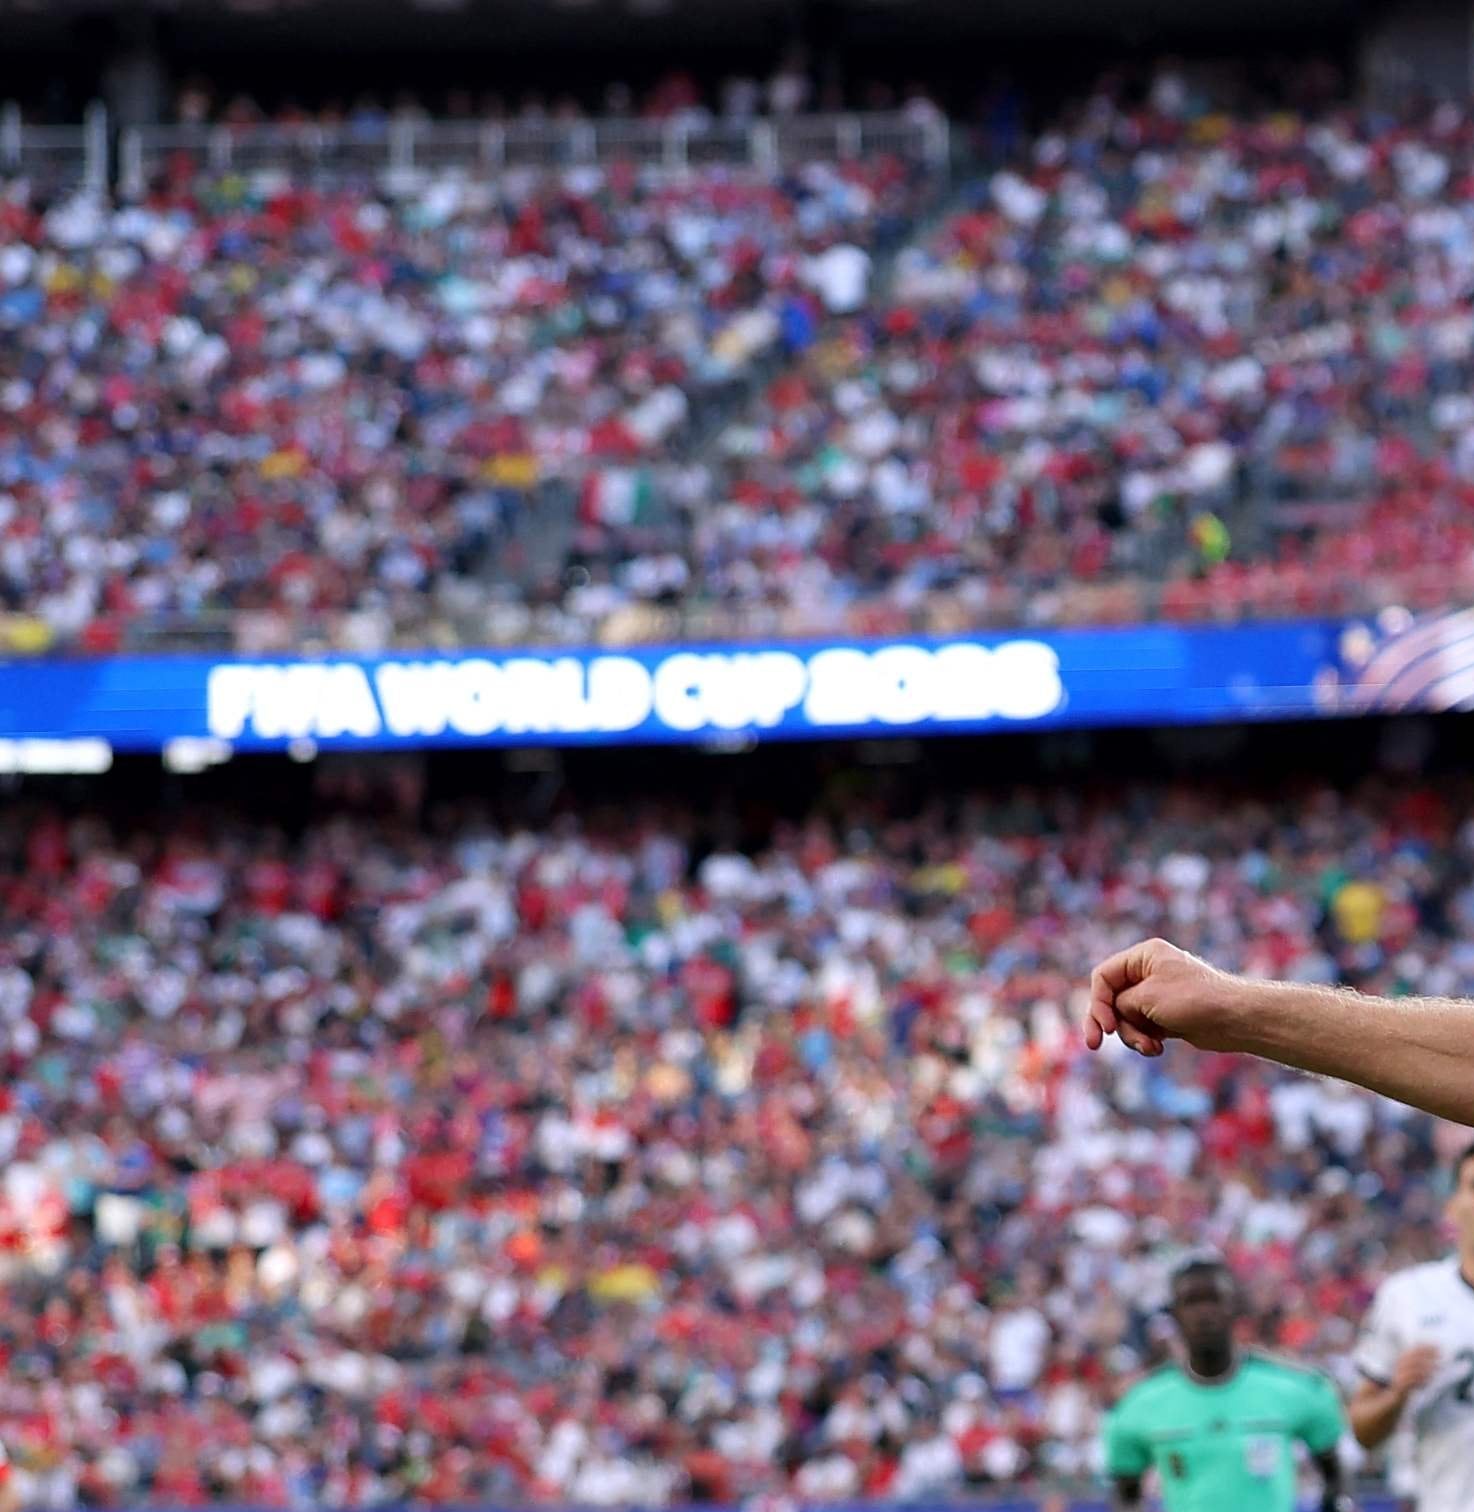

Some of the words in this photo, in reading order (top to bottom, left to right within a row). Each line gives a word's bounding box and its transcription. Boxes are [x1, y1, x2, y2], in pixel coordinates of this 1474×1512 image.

[207, 664, 382, 738] FIFA
[376, 657, 654, 737] WORLD
[652, 650, 807, 730] CUP
